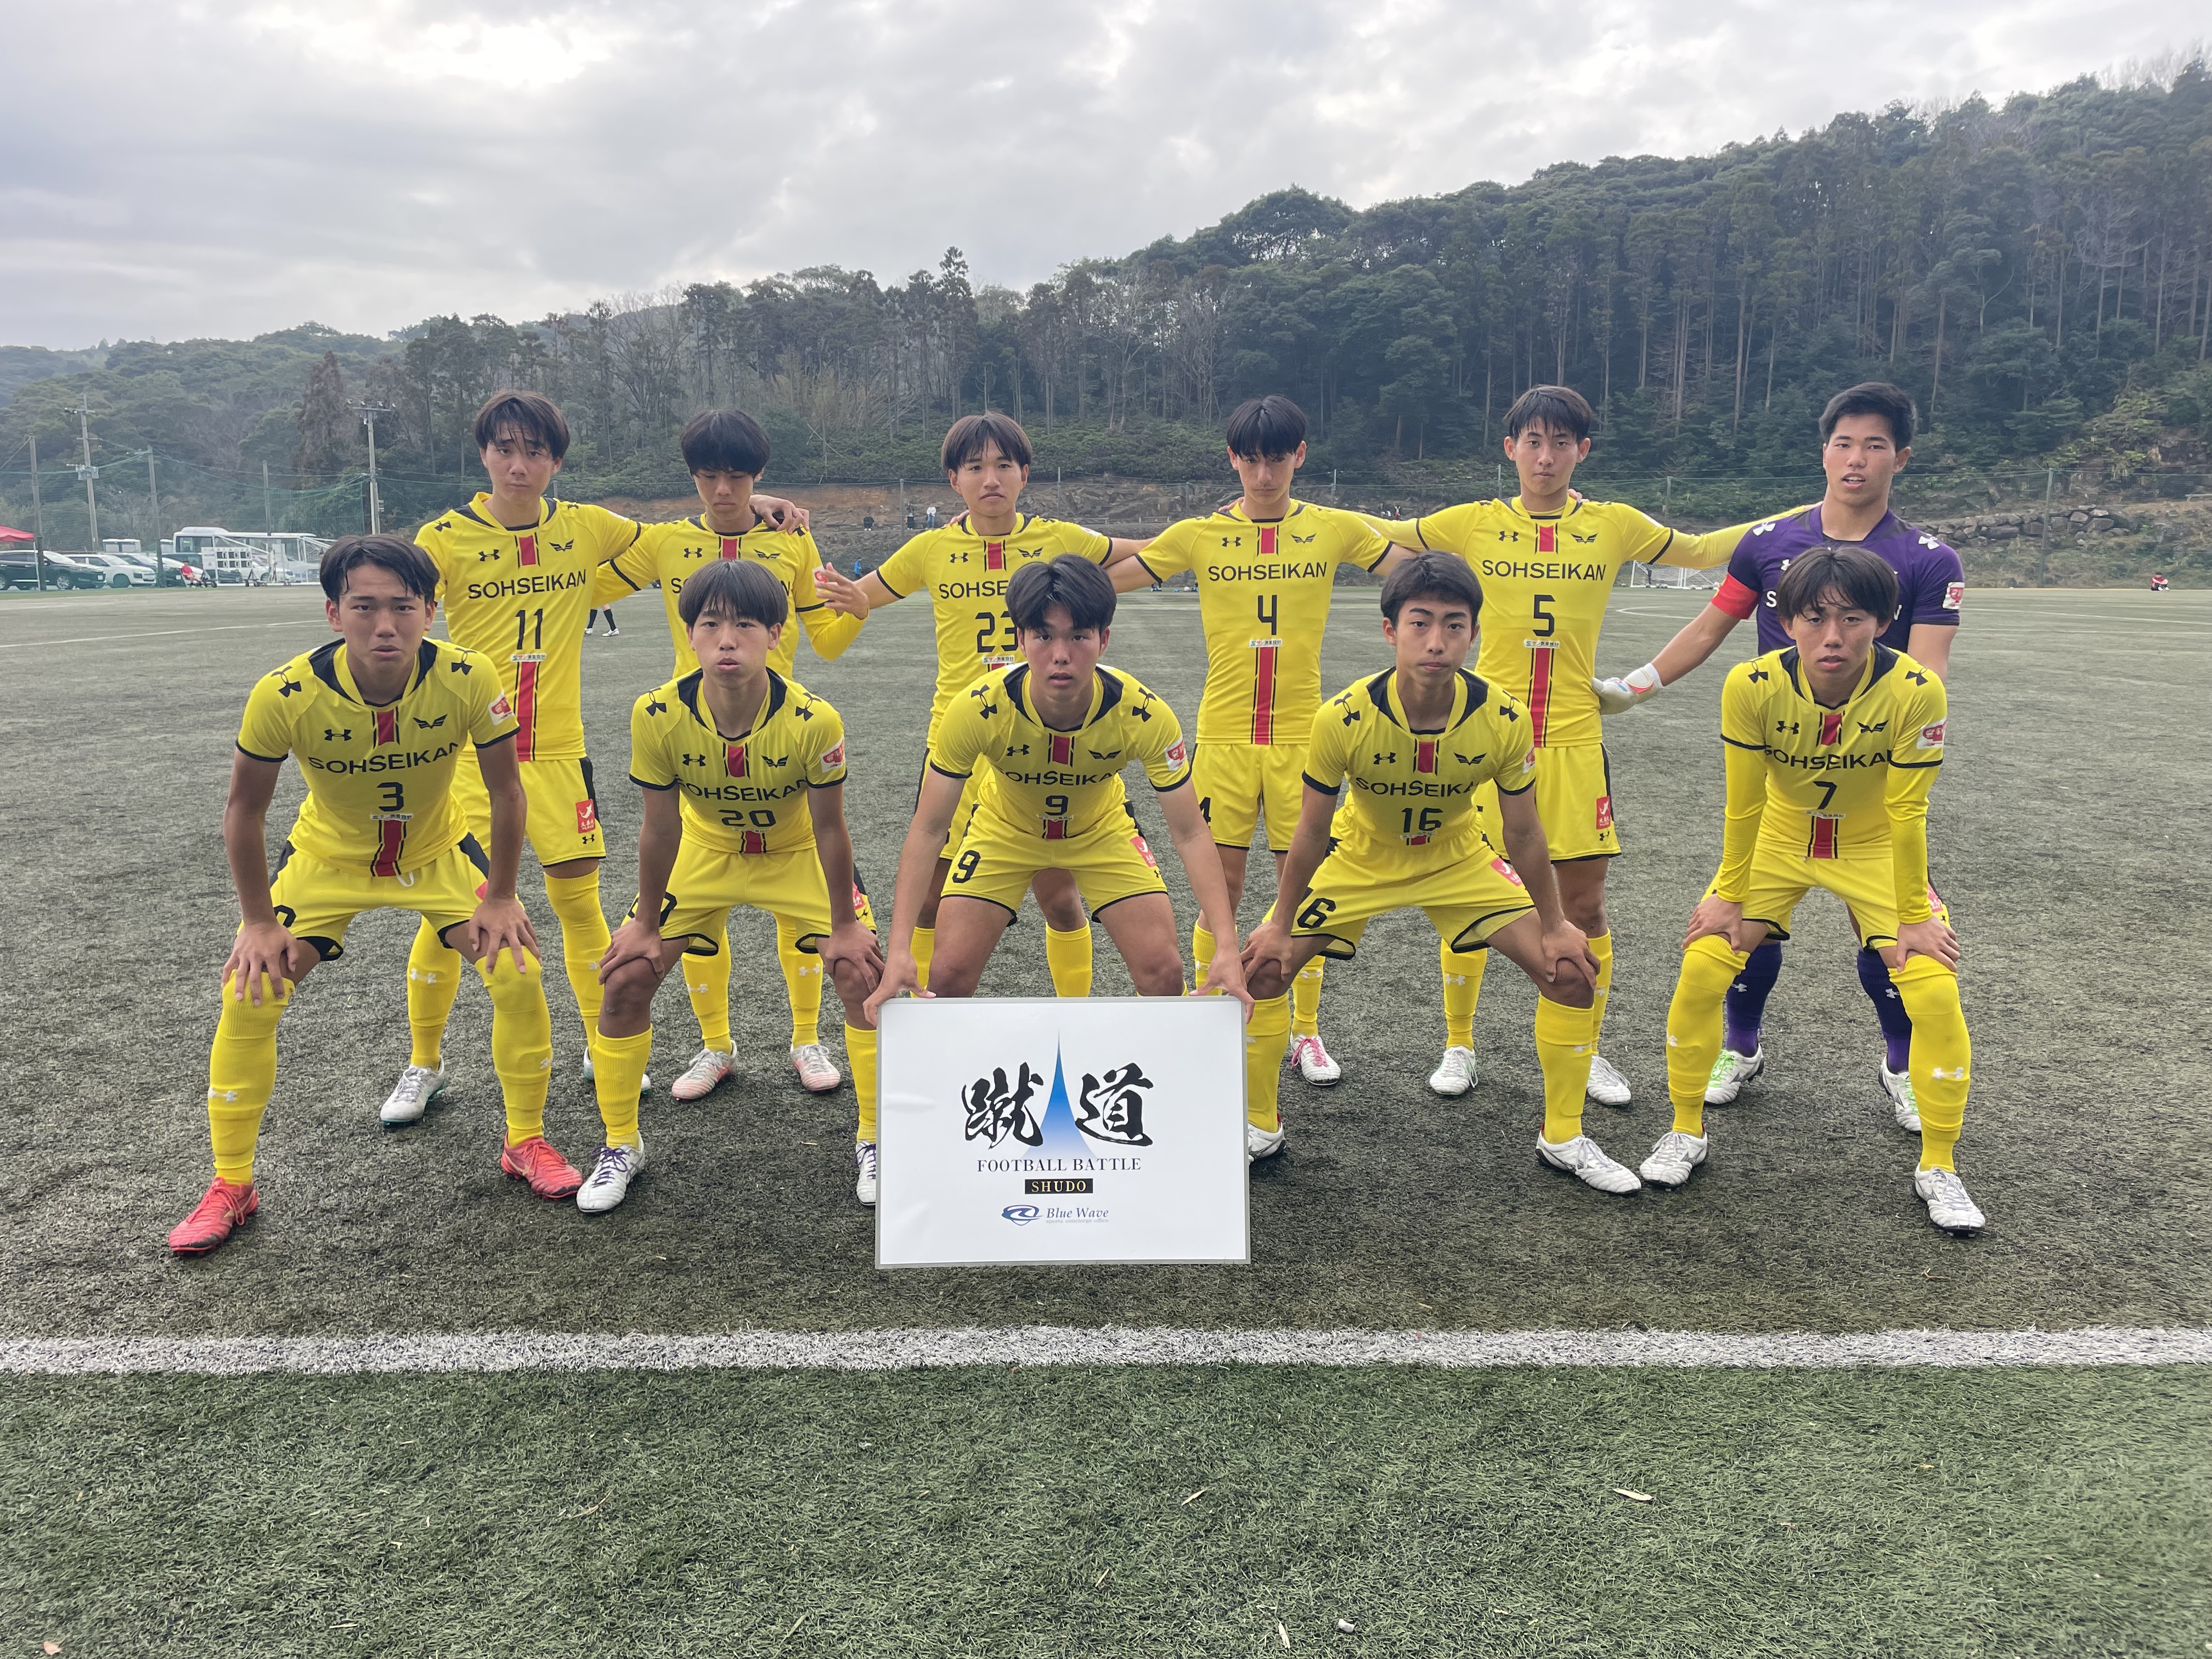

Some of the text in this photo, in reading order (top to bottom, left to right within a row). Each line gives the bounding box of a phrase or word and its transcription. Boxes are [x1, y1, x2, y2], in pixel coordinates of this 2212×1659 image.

[468, 569, 586, 599] SOHSEIKAN
[1208, 562, 1328, 582] SOHSEIKAN
[1482, 560, 1607, 581] SOHSEIKAN
[939, 580, 1009, 599] SOHSE
[1257, 595, 1277, 635] 4
[1532, 594, 1556, 637] 5
[515, 608, 543, 650] 11
[975, 611, 1019, 653] 23
[376, 782, 404, 812] 3
[1045, 795, 1069, 816] 9
[1813, 781, 1837, 810] 7
[718, 809, 777, 827] 20
[1402, 808, 1444, 833] 16
[952, 850, 981, 883] 9
[1297, 898, 1336, 929] 6
[977, 1158, 1142, 1172] FOOTBALL BATTLE
[1030, 1180, 1087, 1193] SHUDO
[1046, 1207, 1109, 1218] Blue Wave
